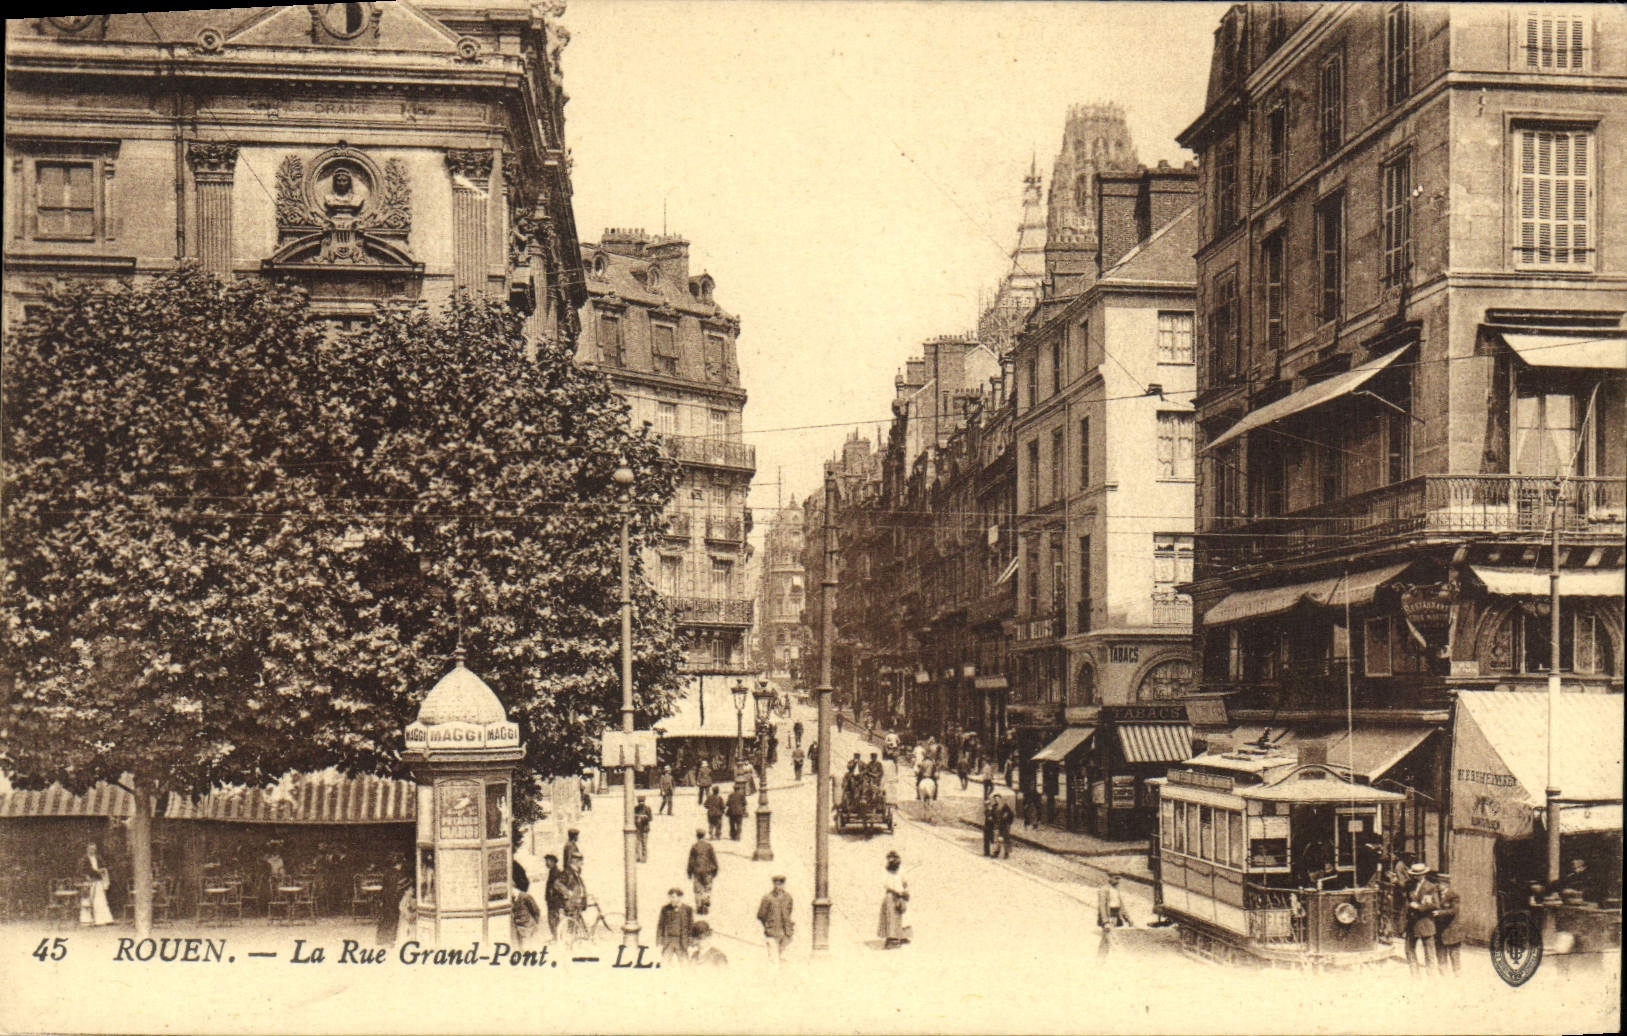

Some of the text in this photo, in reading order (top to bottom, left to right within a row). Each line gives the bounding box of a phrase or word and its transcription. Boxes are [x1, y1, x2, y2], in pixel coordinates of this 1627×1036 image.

[1109, 647, 1139, 664] TABACS
[1114, 706, 1181, 720] TABACS
[405, 727, 427, 742] MAGGI
[429, 727, 482, 742] MAGGI
[487, 726, 518, 741] MAGGI
